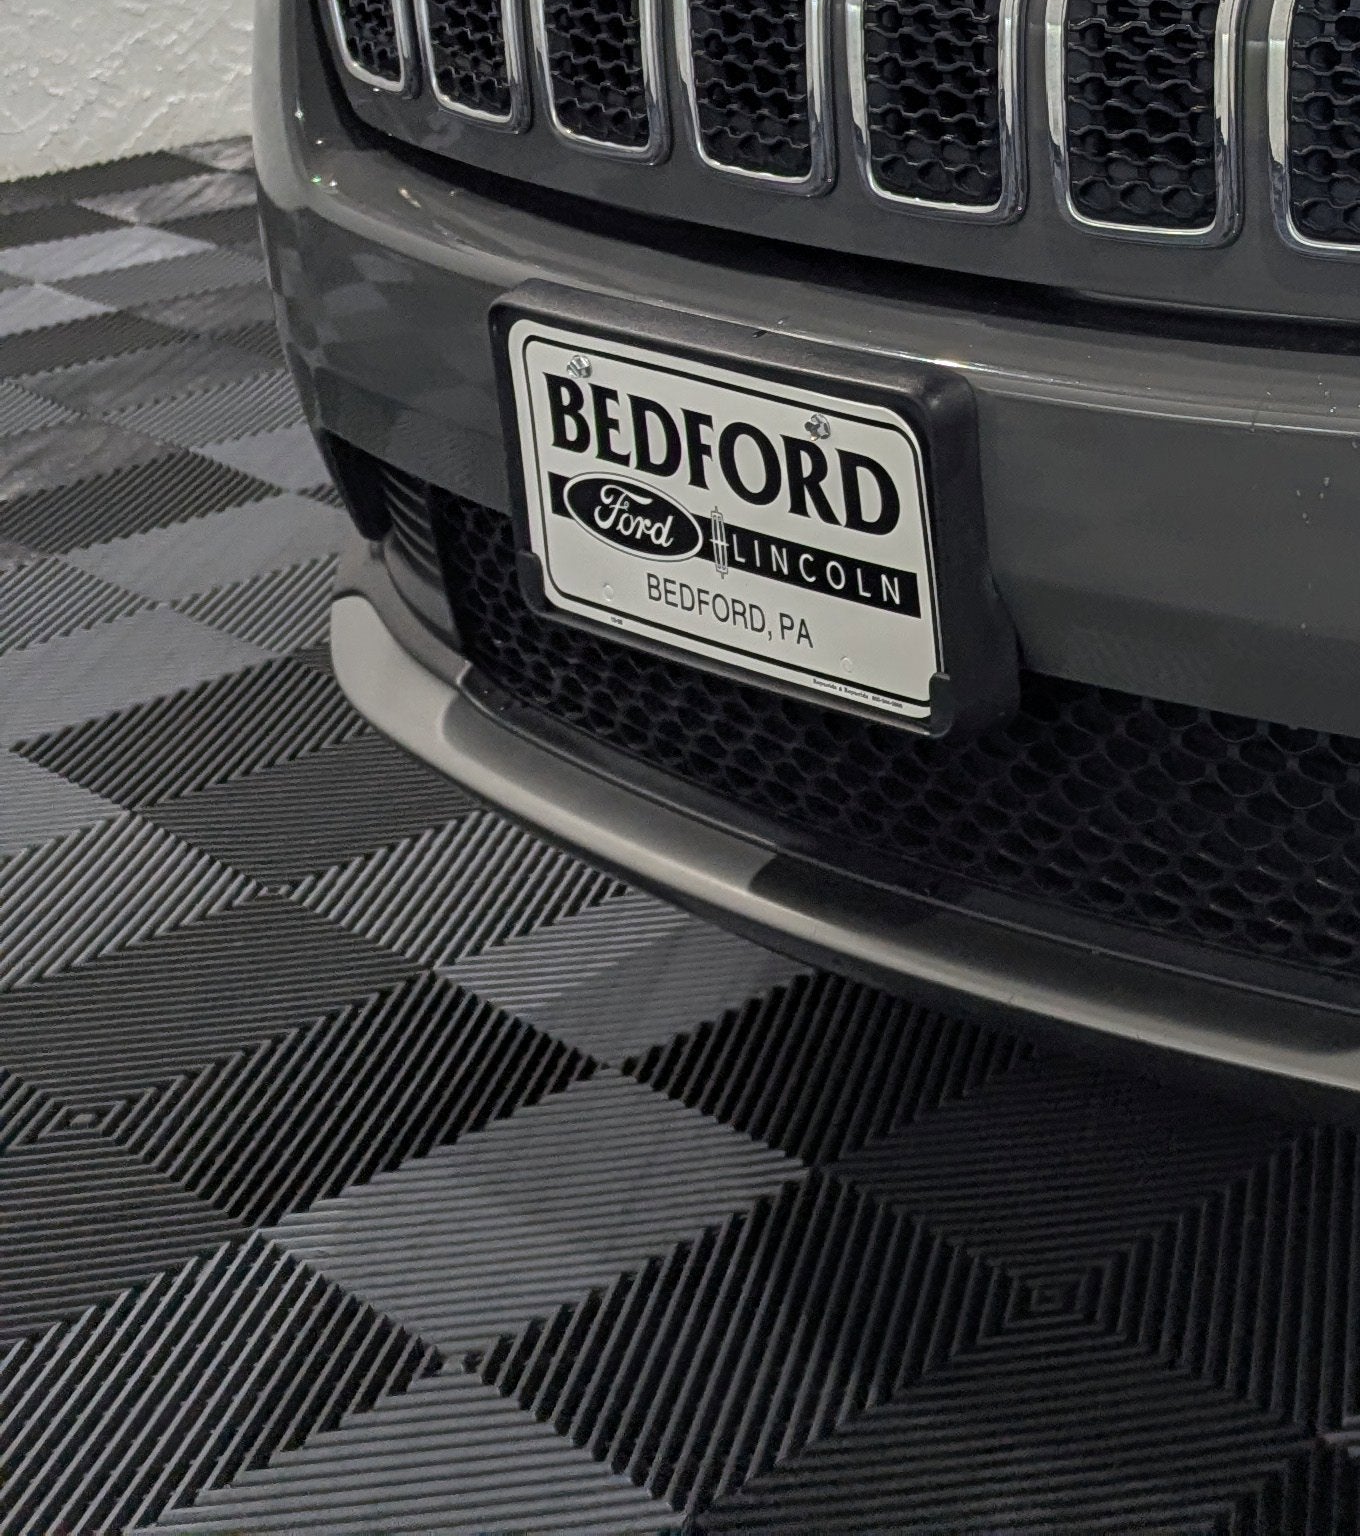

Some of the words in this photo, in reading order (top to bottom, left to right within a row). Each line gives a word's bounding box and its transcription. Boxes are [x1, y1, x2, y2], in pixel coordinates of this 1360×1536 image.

[542, 371, 900, 536] BEDFORD
[593, 484, 674, 547] Ford
[732, 533, 901, 606] LINCOLN
[647, 572, 774, 641] BEDFORD,
[779, 611, 814, 648] PA
